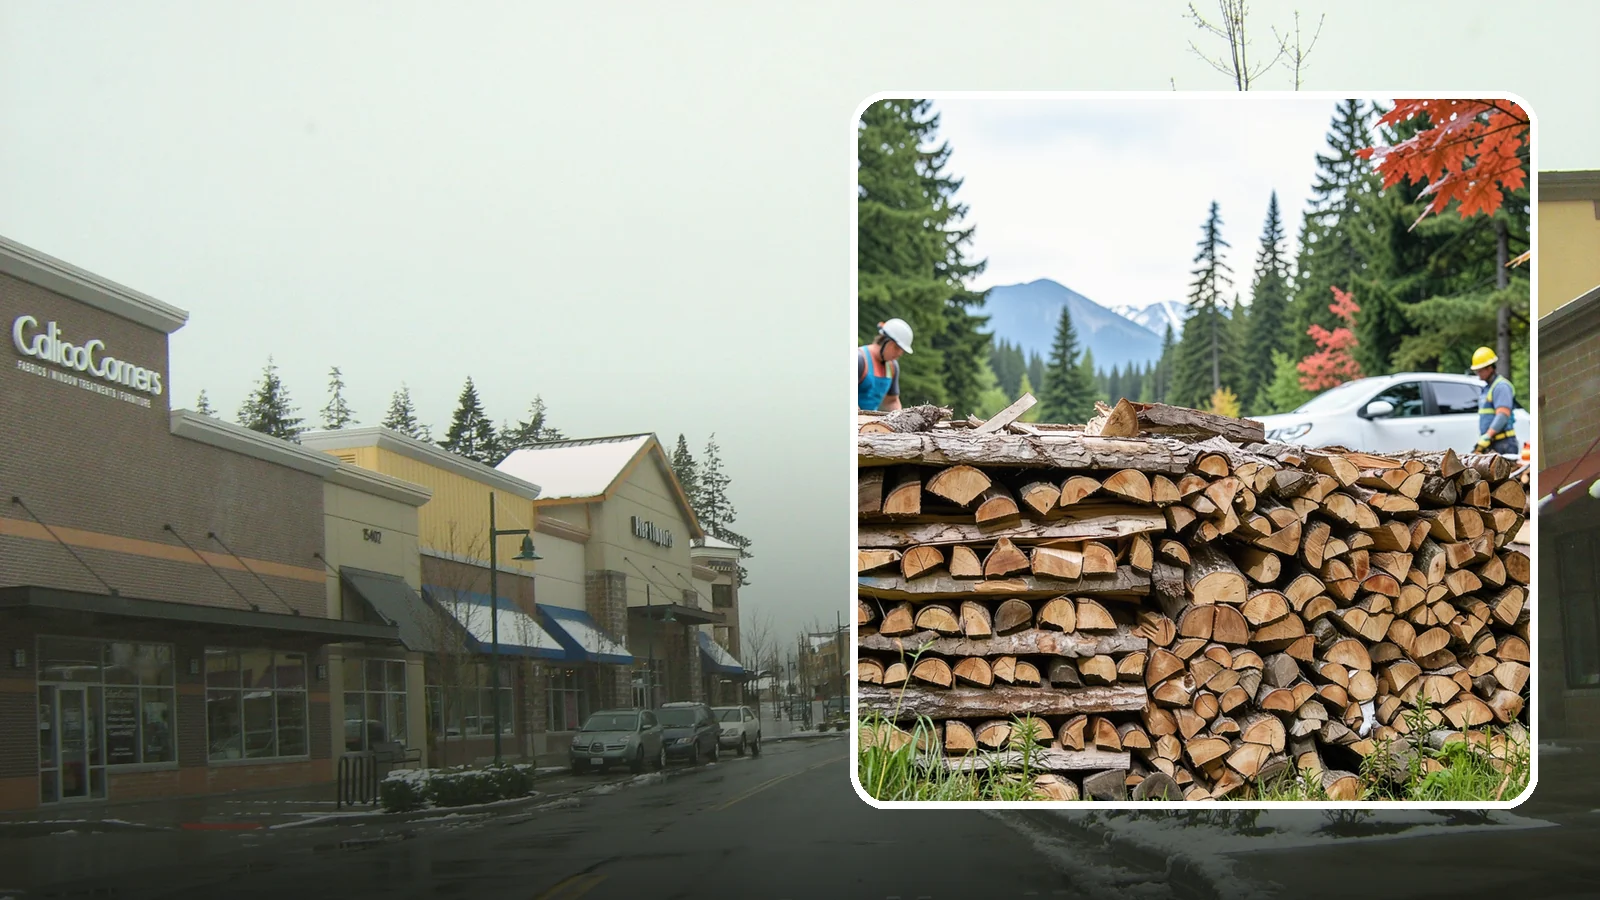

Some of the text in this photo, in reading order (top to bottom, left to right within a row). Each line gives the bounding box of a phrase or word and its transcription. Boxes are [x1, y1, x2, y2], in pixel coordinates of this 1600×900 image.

[16, 360, 46, 377] FABRICS
[51, 370, 78, 387] WINDOW
[78, 378, 116, 398] TREATMENTS
[120, 390, 151, 408] FURNITURE
